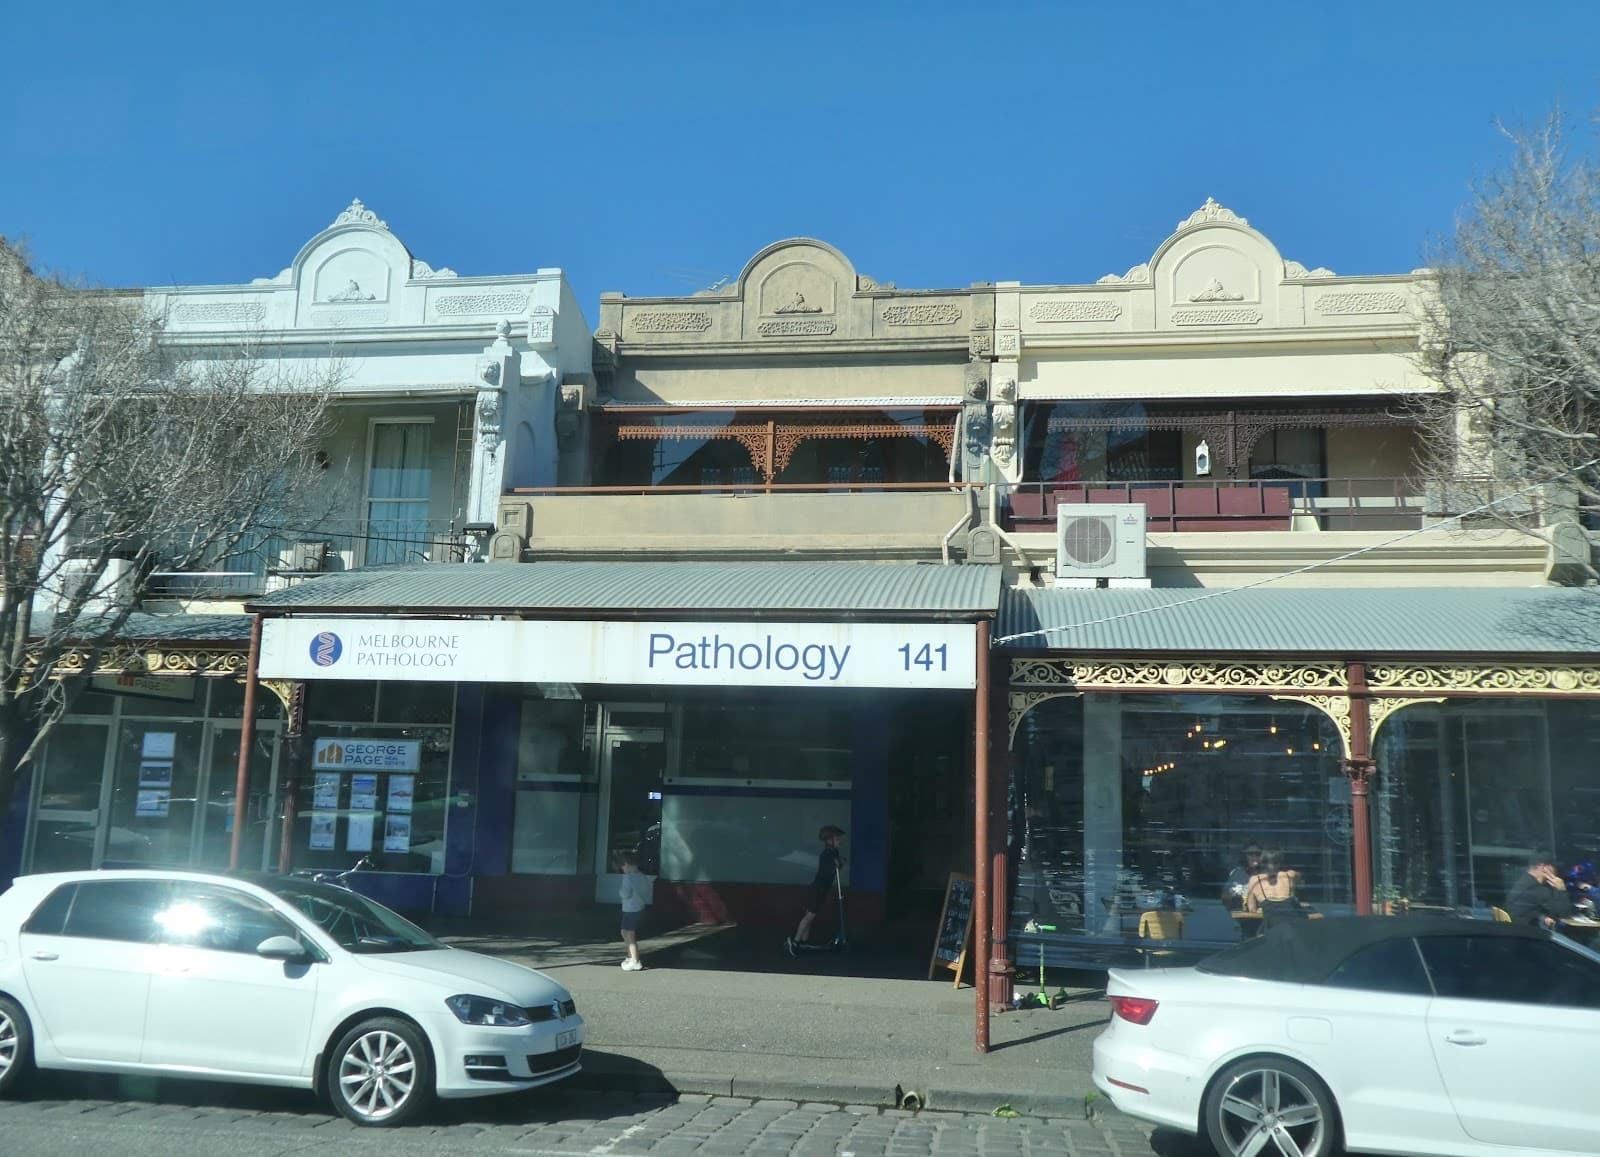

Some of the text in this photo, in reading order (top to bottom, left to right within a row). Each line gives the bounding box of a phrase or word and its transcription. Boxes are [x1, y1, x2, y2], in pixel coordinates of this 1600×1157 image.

[358, 634, 460, 649] MELBOURNE
[357, 652, 458, 667] PATHOLOGY
[647, 633, 948, 681] Pathology 141
[345, 744, 406, 755] GEORGE
[344, 755, 383, 765] PAGE
